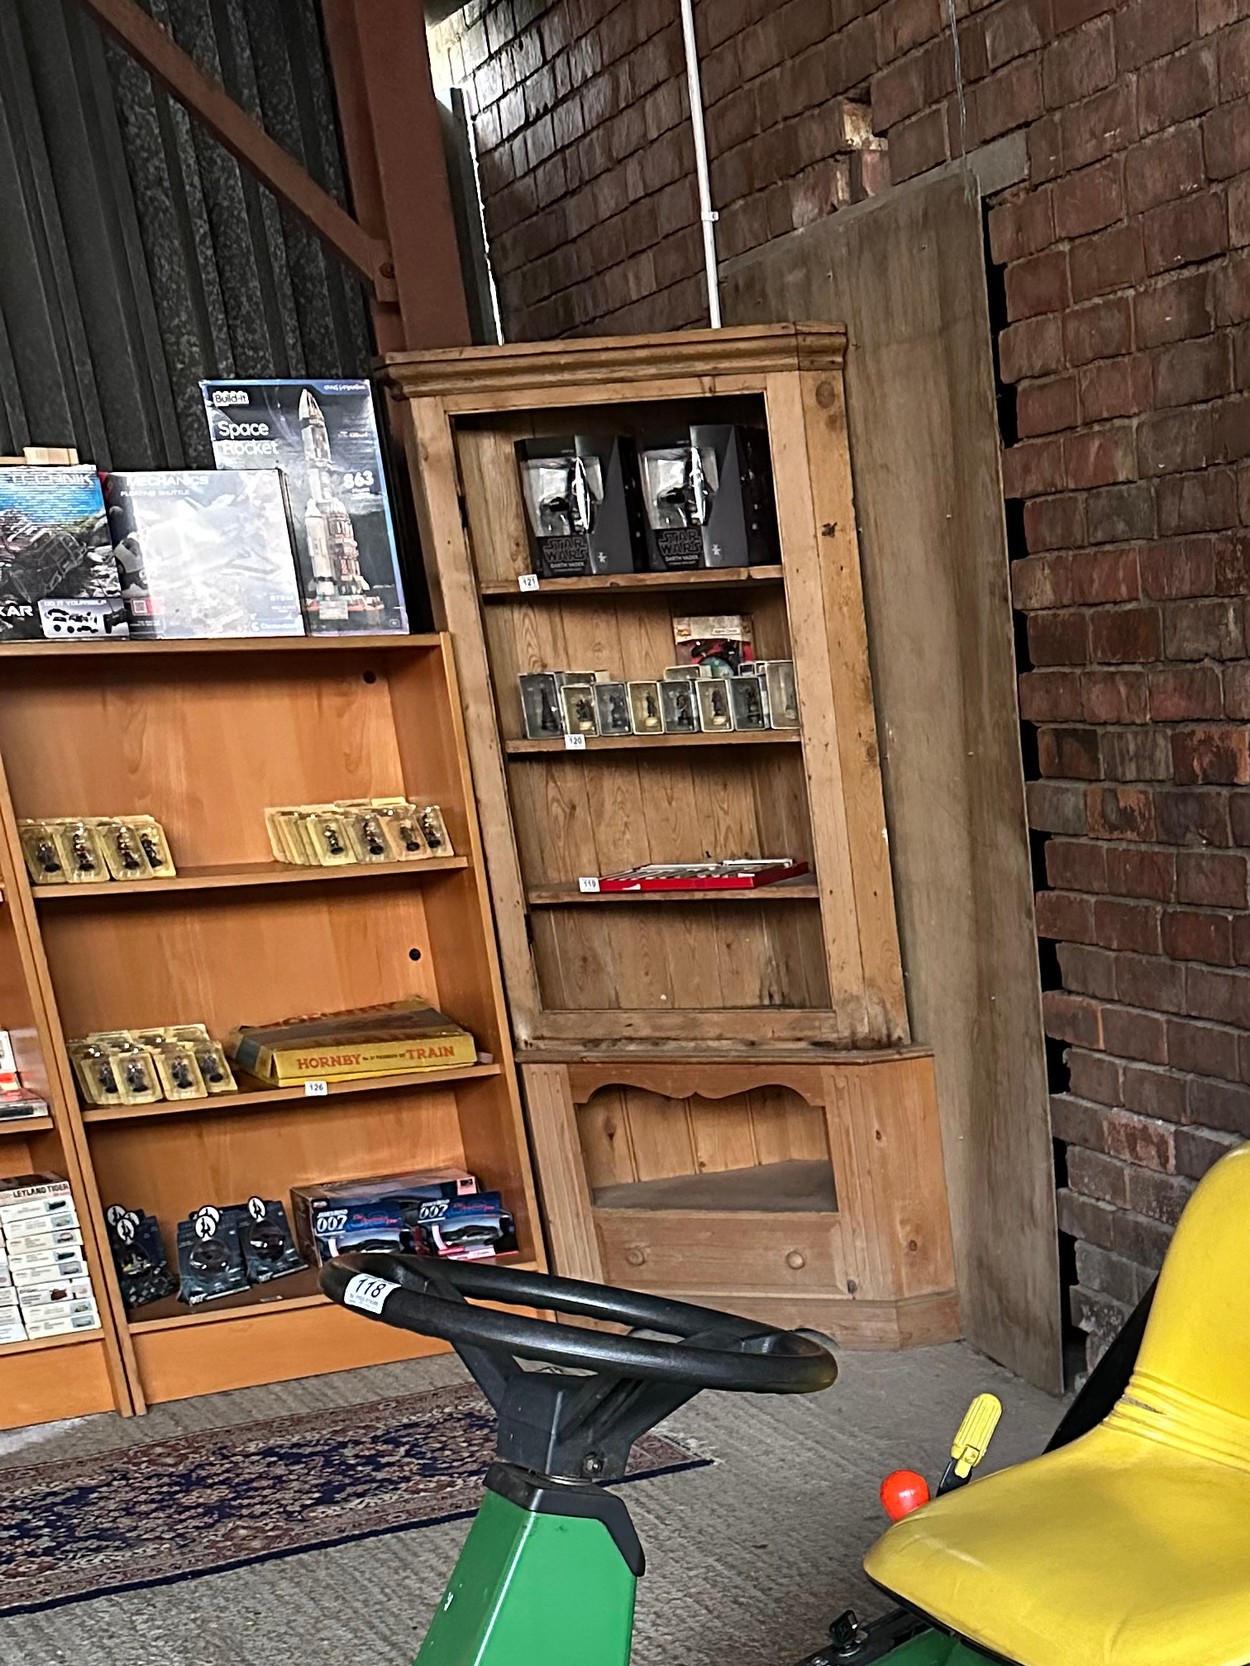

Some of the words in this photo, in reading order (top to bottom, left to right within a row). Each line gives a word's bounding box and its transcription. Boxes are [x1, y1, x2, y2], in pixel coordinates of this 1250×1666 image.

[217, 421, 269, 439] Space
[222, 439, 280, 455] Rocket
[126, 475, 209, 487] MECHANICS
[343, 470, 375, 489] 863
[543, 537, 587, 551] STAR
[659, 529, 701, 544] STAR
[543, 548, 588, 562] WARS
[659, 541, 702, 556] WARS
[523, 578, 536, 587] 121
[297, 1054, 361, 1070] HORNBY
[406, 1046, 455, 1060] TRAIN
[309, 1083, 324, 1092] 126
[13, 1187, 46, 1198] LEYLAND
[46, 1183, 69, 1193] TIGER
[419, 1204, 448, 1219] 007
[316, 1215, 348, 1232] 007
[355, 1278, 386, 1298] 118
